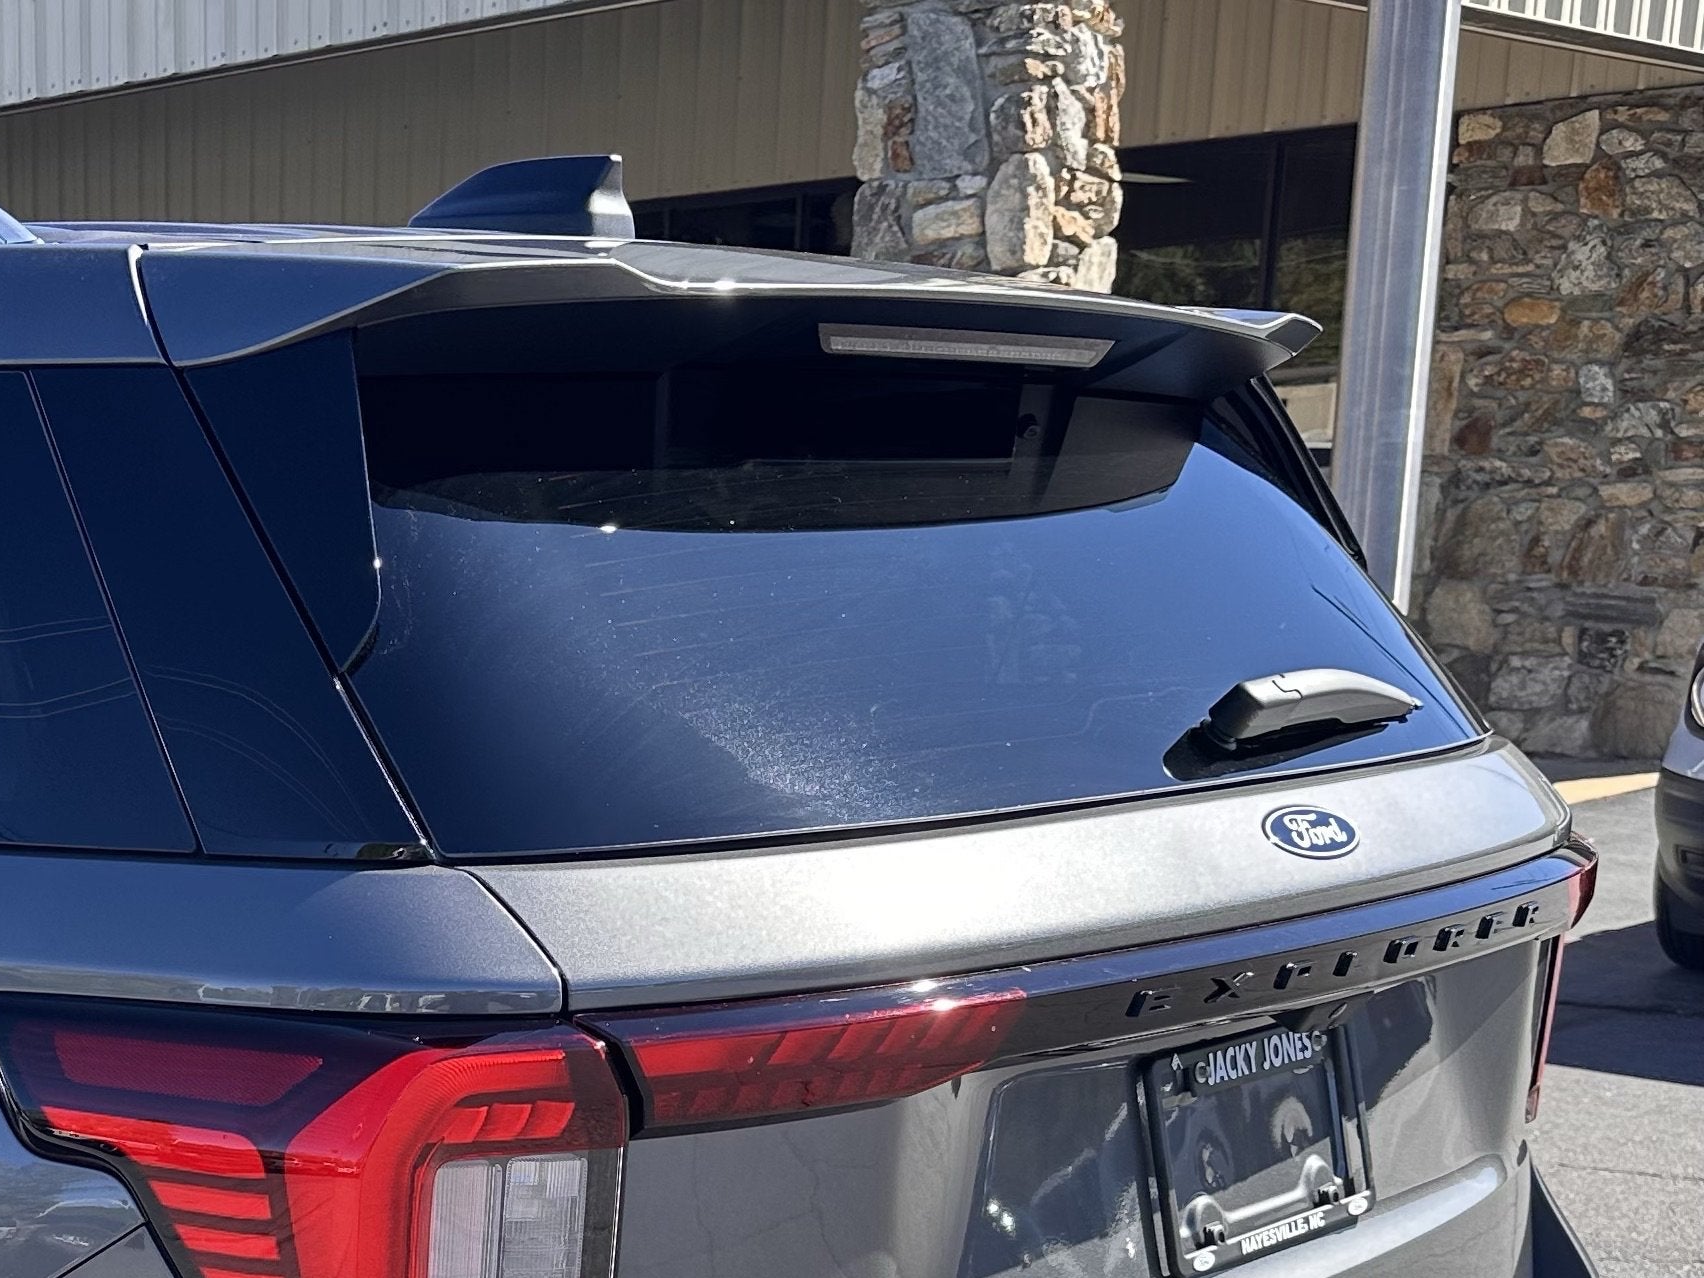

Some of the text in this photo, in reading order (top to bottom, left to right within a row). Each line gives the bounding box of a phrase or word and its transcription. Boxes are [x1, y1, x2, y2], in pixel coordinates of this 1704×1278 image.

[1283, 809, 1348, 849] Ford
[1207, 1031, 1313, 1085] JACKY JONES
[1309, 1211, 1326, 1230] NC
